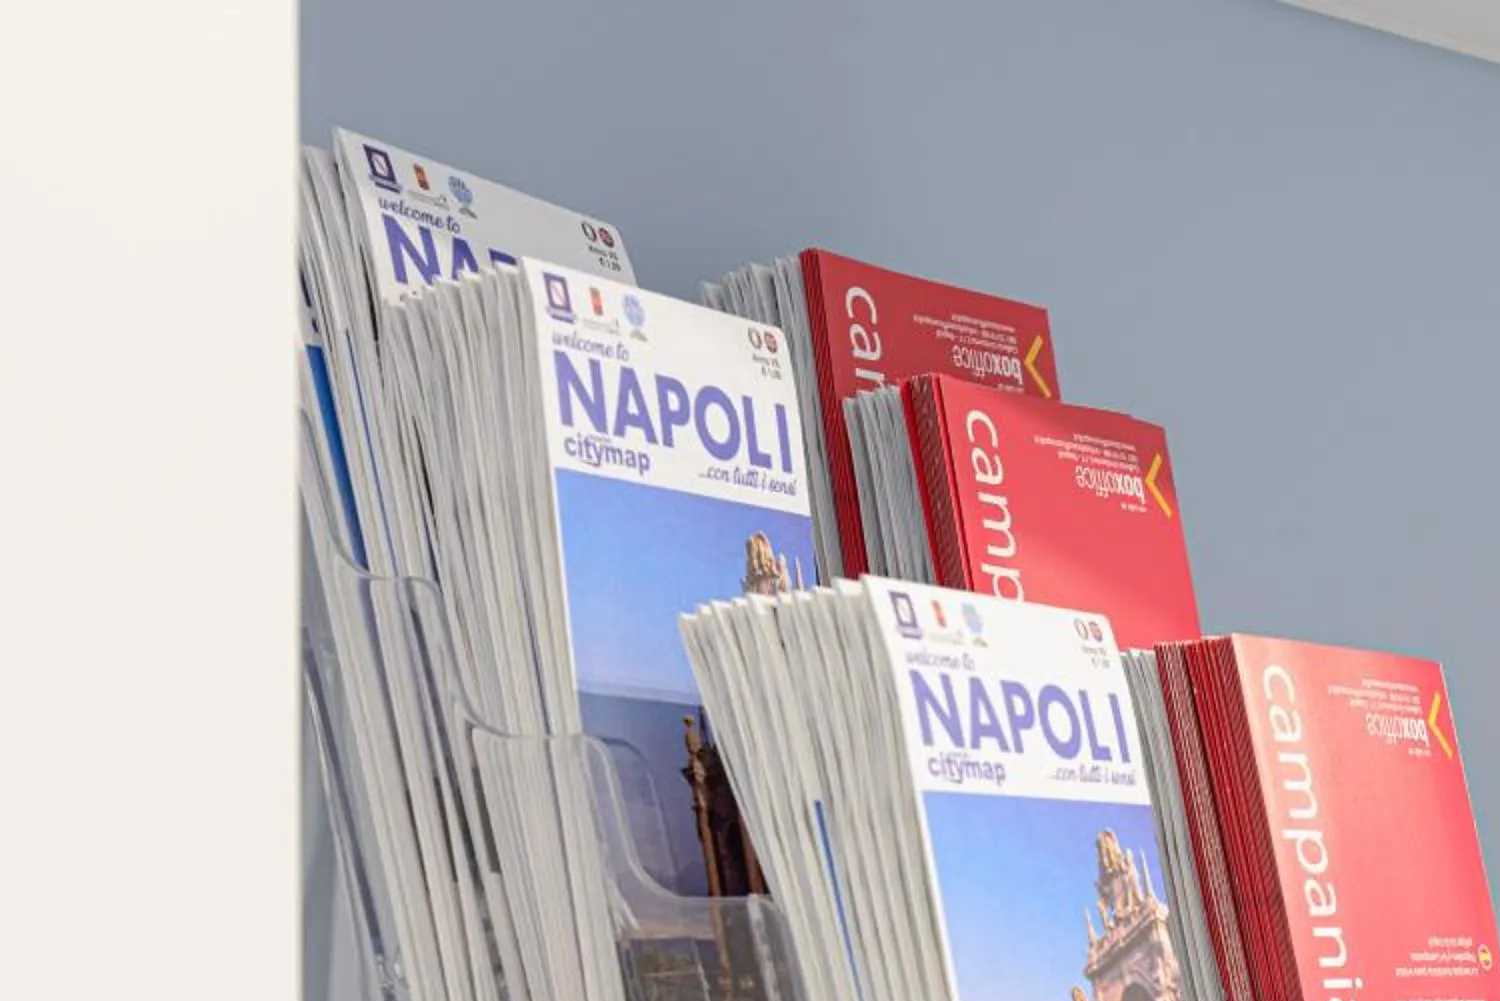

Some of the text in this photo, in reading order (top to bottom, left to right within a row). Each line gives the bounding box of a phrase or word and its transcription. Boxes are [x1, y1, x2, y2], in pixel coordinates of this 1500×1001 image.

[378, 196, 444, 229] welcome
[447, 214, 461, 233] to
[382, 213, 517, 286] NA
[552, 329, 630, 362] welcome to
[952, 345, 1023, 385] boxoffice
[553, 350, 794, 474] NAPOLI
[564, 432, 651, 476] citymap
[1075, 465, 1145, 505] boxoffice
[909, 669, 1132, 764] NAPOLI
[928, 752, 1006, 786] citymap
